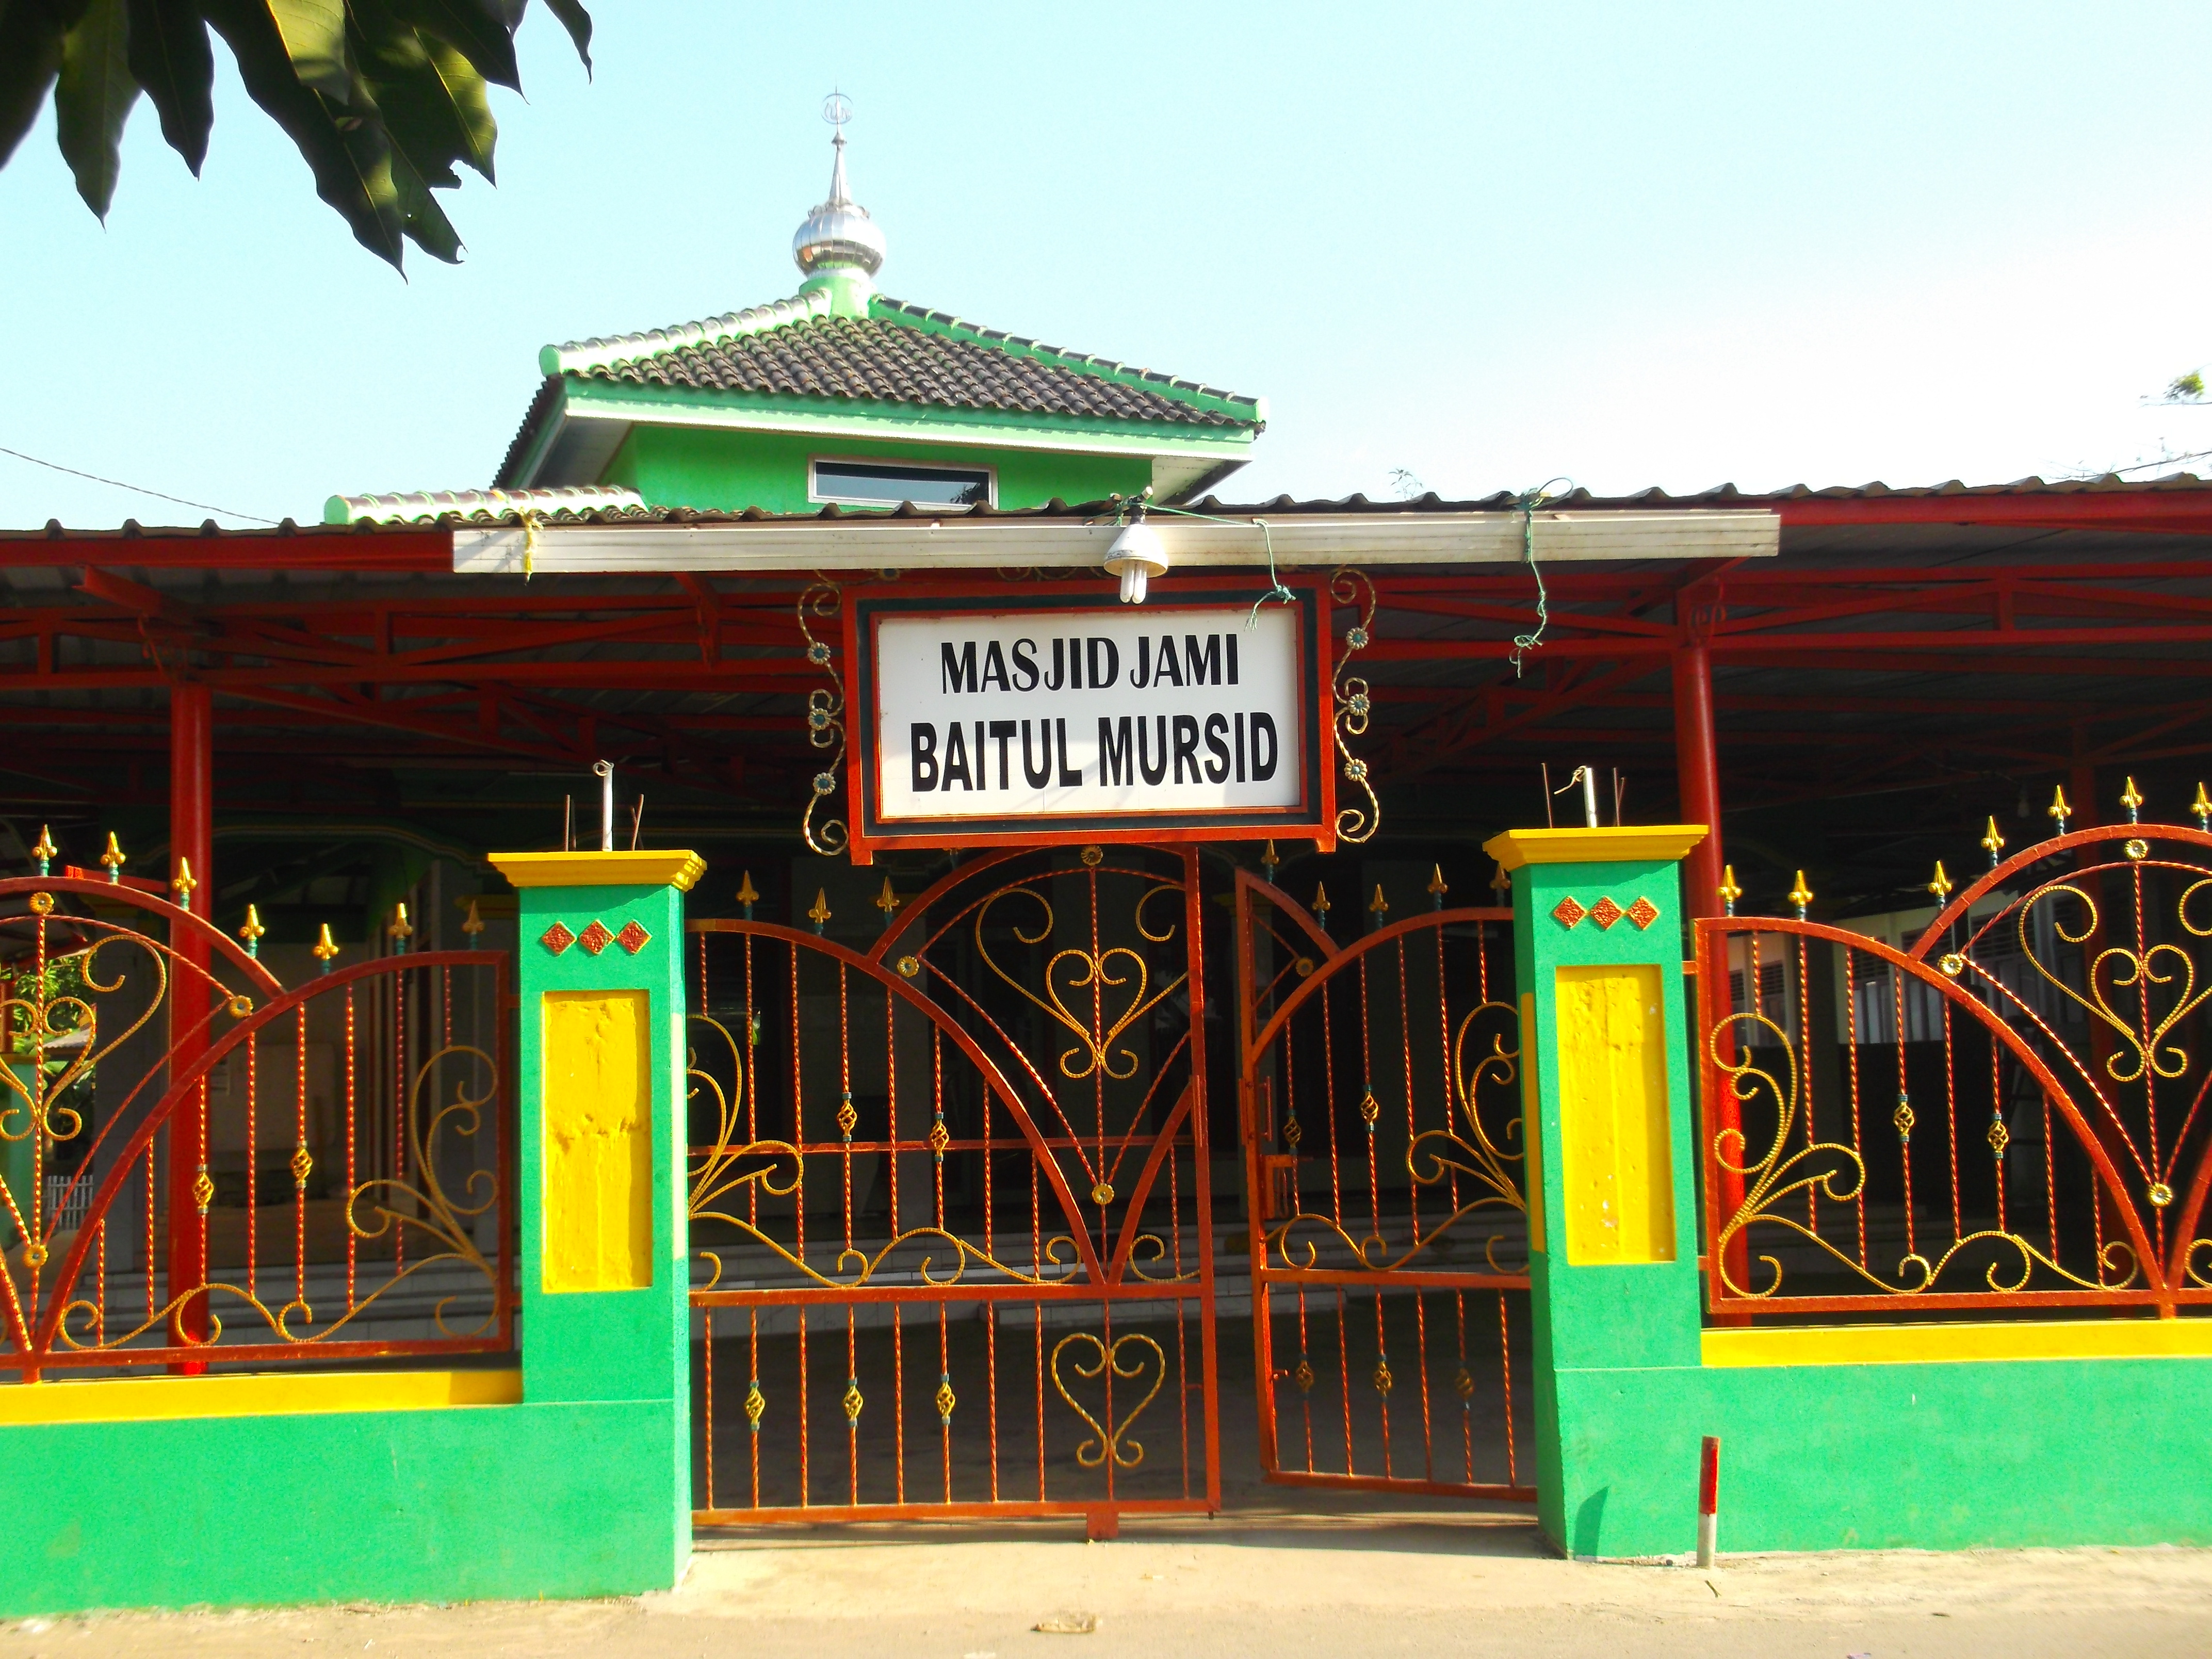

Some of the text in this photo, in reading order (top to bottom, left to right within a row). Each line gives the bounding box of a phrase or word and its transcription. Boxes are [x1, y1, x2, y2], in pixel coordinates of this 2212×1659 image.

[941, 633, 1239, 694] MASJID JAMI
[911, 712, 1278, 792] BAITUL MURSID
